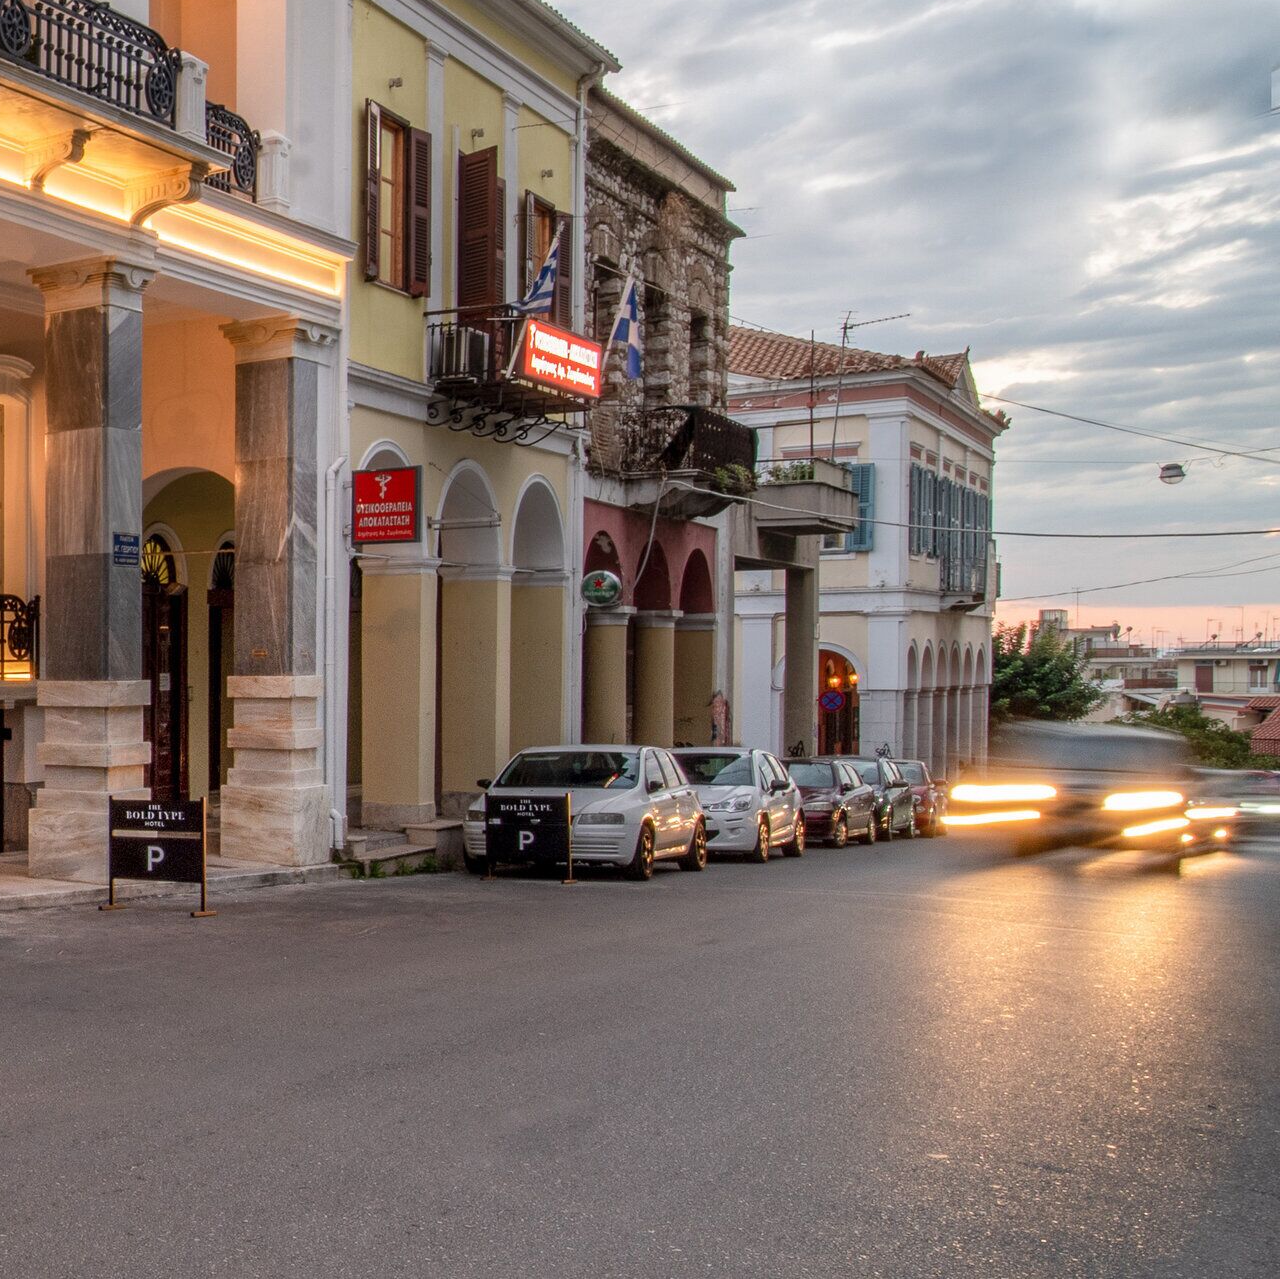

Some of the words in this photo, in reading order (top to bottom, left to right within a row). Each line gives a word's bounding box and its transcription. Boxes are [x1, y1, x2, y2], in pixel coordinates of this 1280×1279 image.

[356, 501, 413, 514] ΦΥΣΙΚΟΘΕΡΑΠΕΙΑ
[358, 515, 410, 527] ΑΠΟΚΑΤΑΣΤΑΣΗ
[126, 811, 155, 820] BOLD
[158, 811, 185, 820] TYPE
[519, 830, 535, 851] P
[147, 845, 165, 871] P
